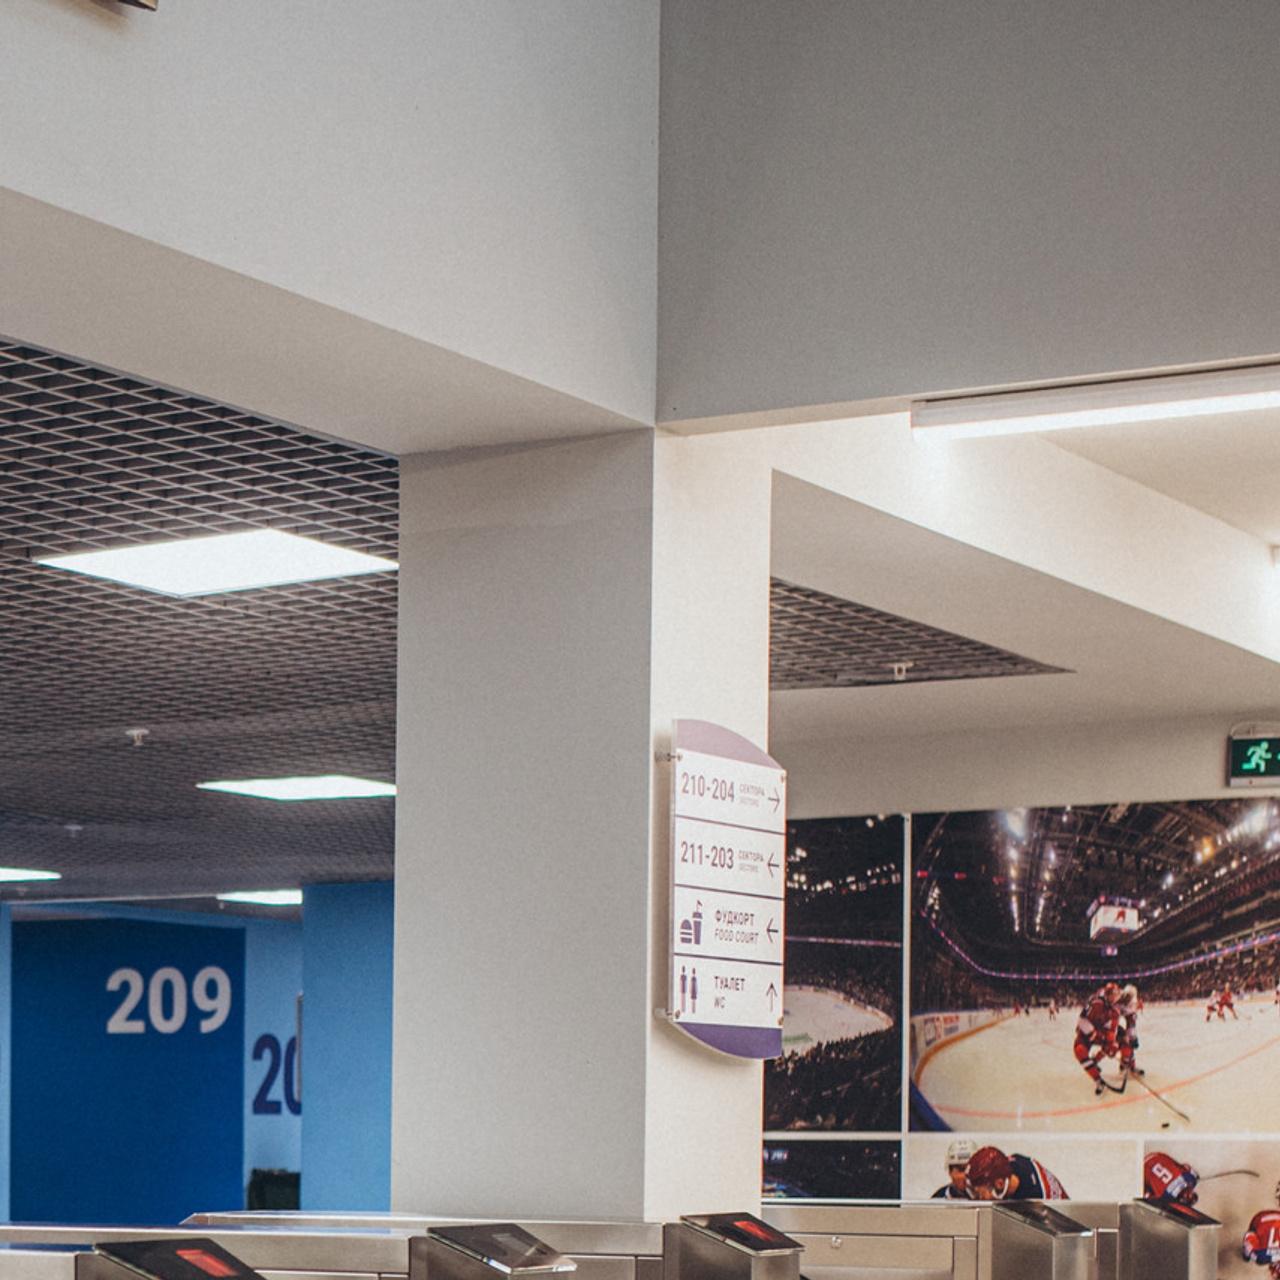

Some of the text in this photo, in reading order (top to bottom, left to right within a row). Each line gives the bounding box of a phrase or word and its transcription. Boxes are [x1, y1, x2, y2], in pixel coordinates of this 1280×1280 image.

[682, 772, 734, 802] 210-204
[681, 841, 734, 869] 211-203
[715, 910, 754, 926] ФУДКОРТ
[715, 928, 759, 945] FOOD COURT
[714, 975, 746, 992] ТУАЛЕТ
[106, 965, 232, 1034] 209
